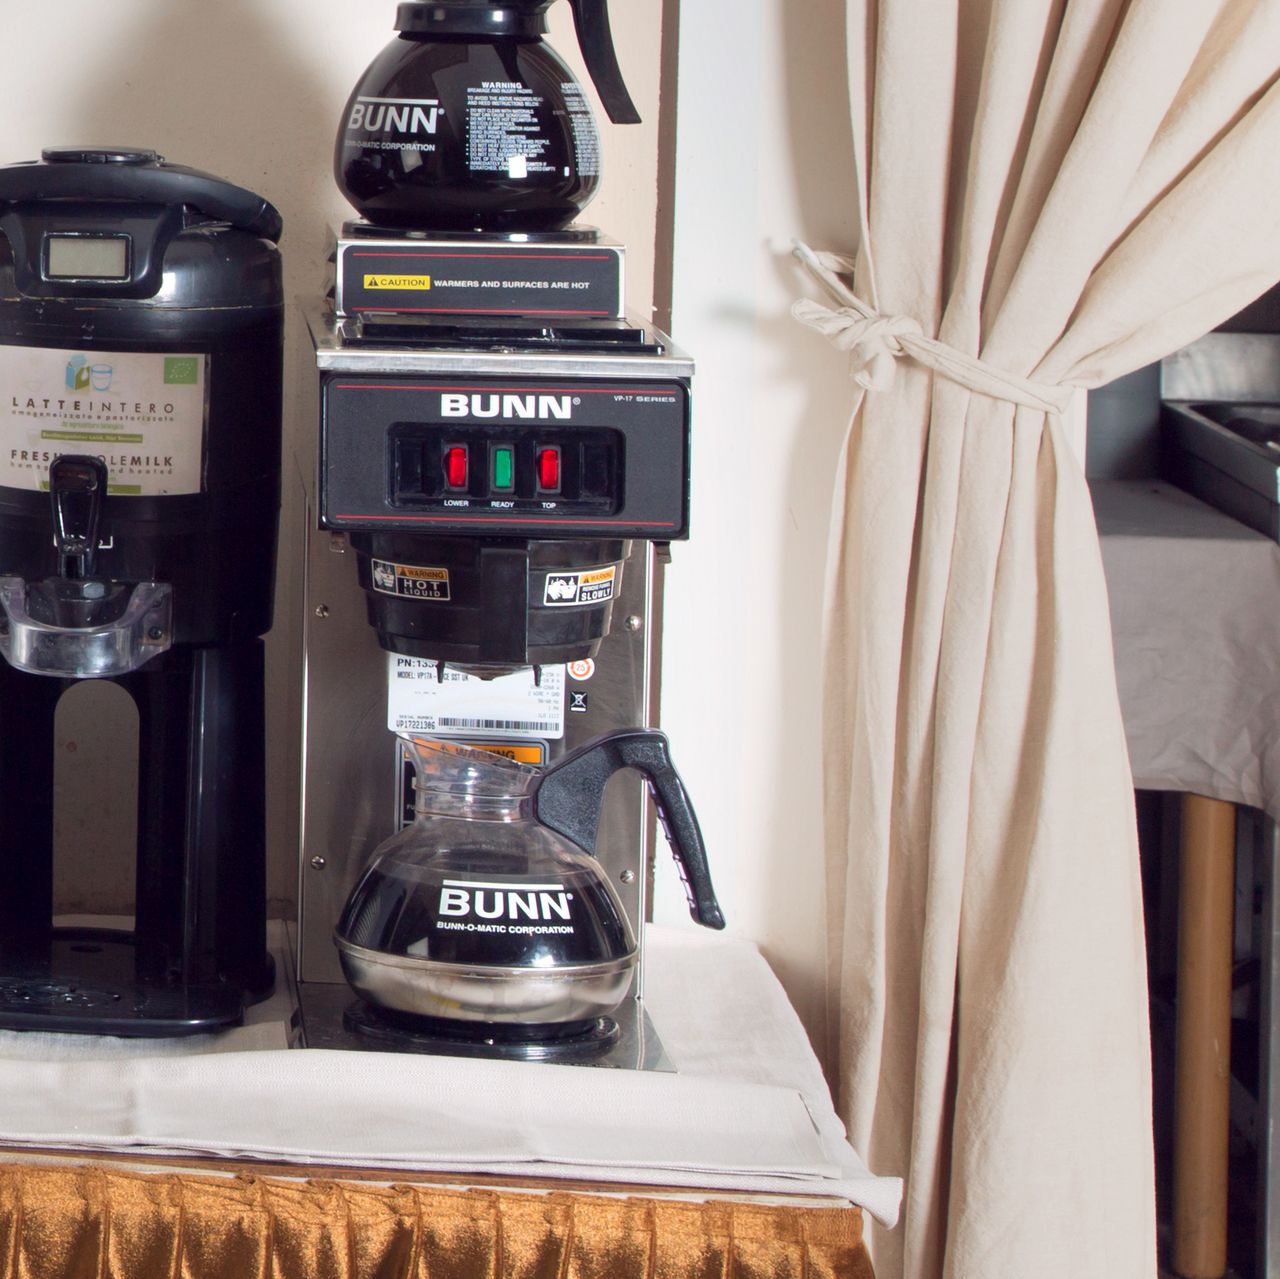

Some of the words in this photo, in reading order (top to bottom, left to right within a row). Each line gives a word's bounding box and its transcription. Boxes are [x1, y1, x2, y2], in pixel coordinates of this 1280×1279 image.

[481, 81, 523, 89] WARNING
[347, 103, 438, 134] BUNN
[344, 140, 380, 149] -O-MATIC
[381, 141, 436, 152] CORPORATION
[380, 278, 426, 287] CAUTION
[434, 280, 479, 289] WARMERS
[481, 281, 500, 289] AND
[502, 281, 549, 289] SURFACES
[551, 281, 570, 289] ARE
[571, 282, 590, 290] HOT
[441, 393, 572, 419] BUNN
[407, 569, 444, 579] WARNING
[403, 578, 440, 591] HOT
[403, 588, 441, 597] LIQUID
[581, 588, 611, 601] SLOWLY
[397, 671, 414, 680] MODEL:
[456, 744, 515, 761] WAING
[439, 887, 572, 920] BUNN
[436, 921, 507, 934] BUNN-O-MATIC
[508, 924, 574, 935] CORPORATION
